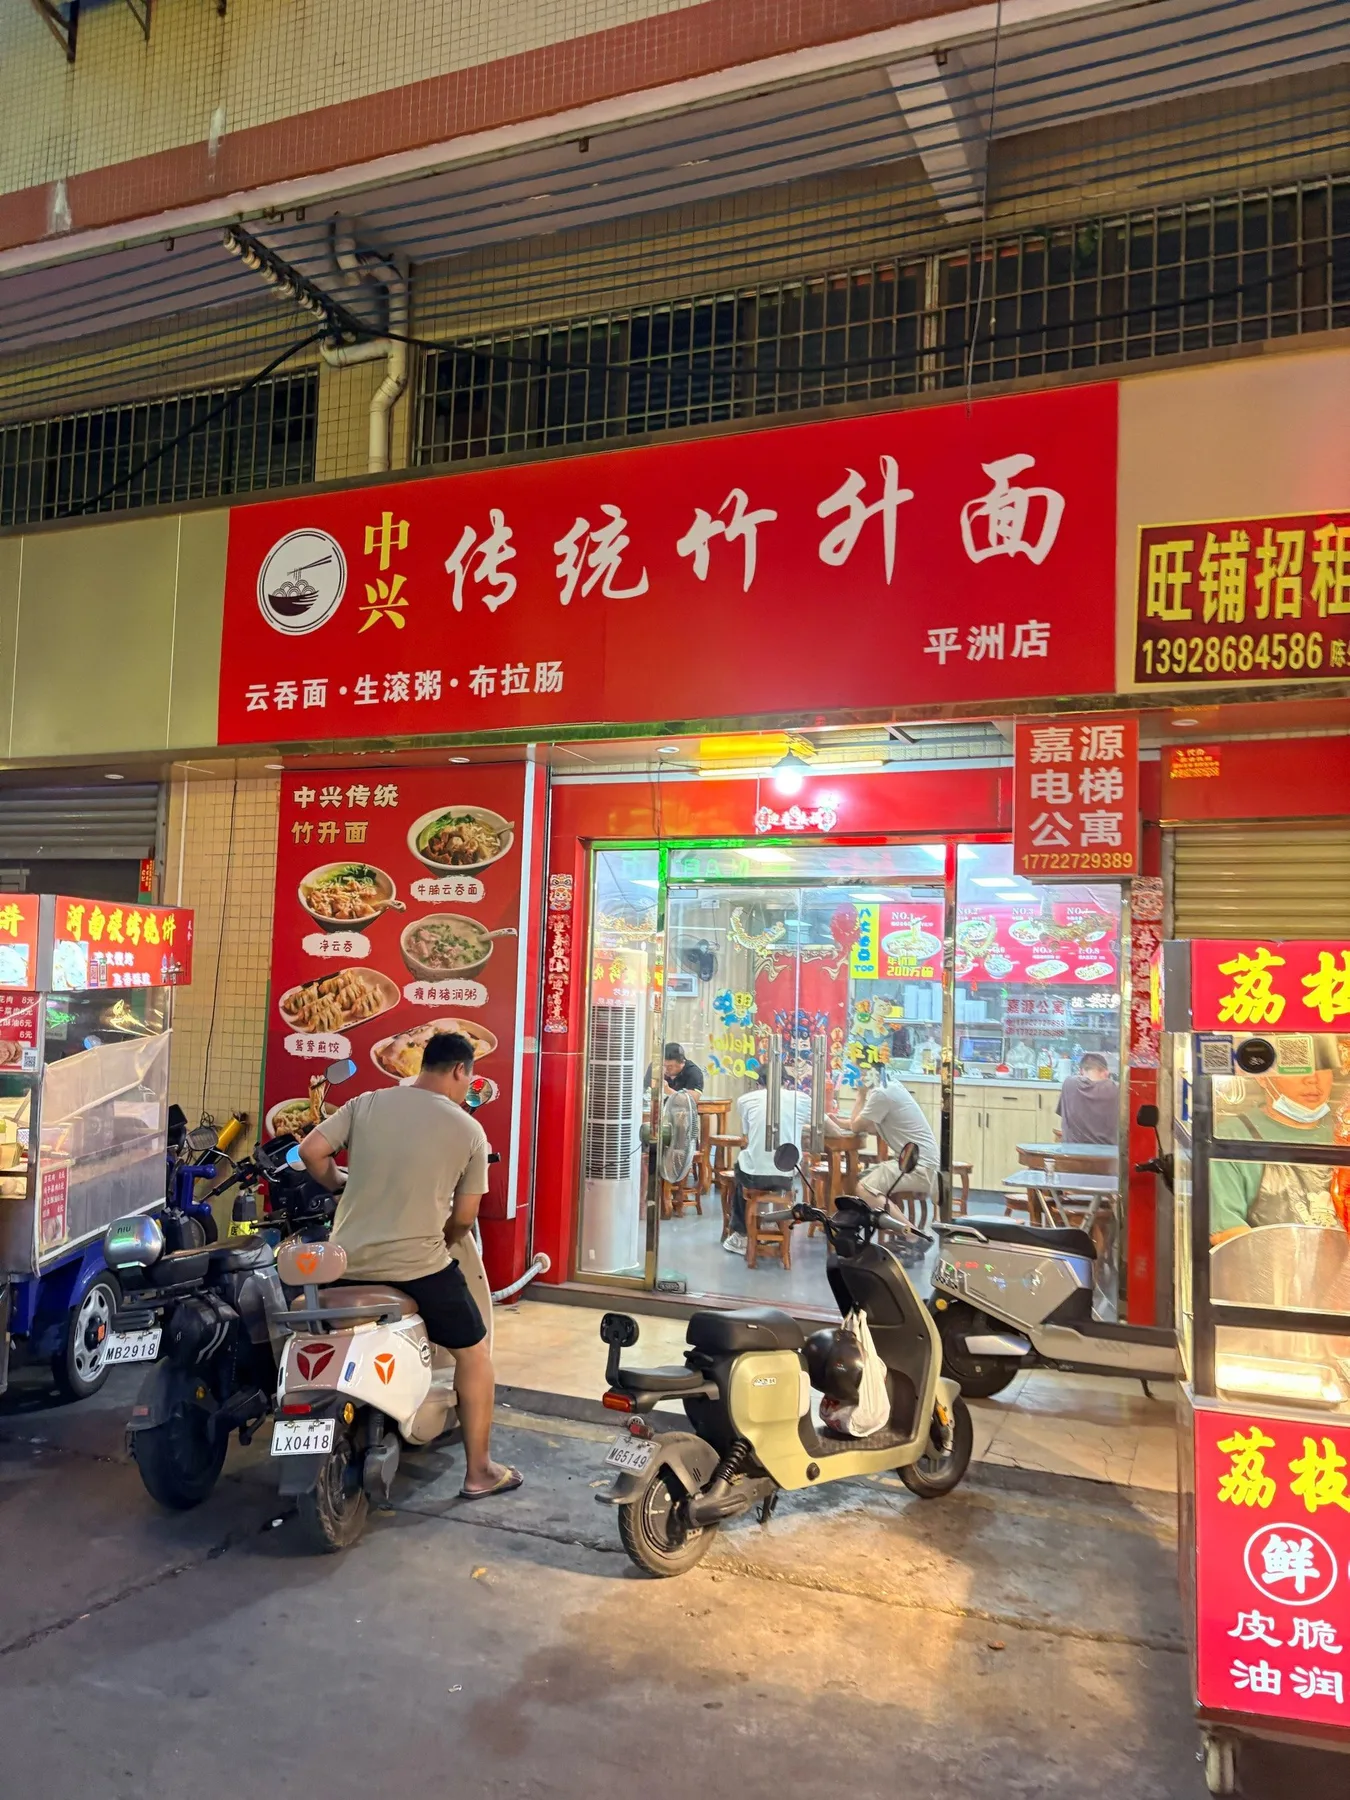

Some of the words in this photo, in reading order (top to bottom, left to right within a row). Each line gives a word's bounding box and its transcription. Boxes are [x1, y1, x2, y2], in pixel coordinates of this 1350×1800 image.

[444, 453, 1065, 612] 传统竹升面
[358, 512, 410, 634] 中兴
[1147, 522, 1350, 624] 旺铺招租
[923, 619, 1051, 664] 平洲店
[1142, 632, 1322, 674] 13928684586
[1329, 637, 1350, 669] 陈
[1029, 725, 1126, 764] 嘉源
[293, 784, 399, 809] 中兴传统
[1030, 767, 1124, 804] 电梯
[291, 821, 368, 844] 竹升面
[1028, 810, 1123, 847] 公寓
[1021, 852, 1133, 870] 17722729389
[319, 940, 353, 952] 净云吞
[413, 986, 478, 1001] 瘦肉猪润粥
[295, 1038, 340, 1054] 鸳鸯煎饺
[106, 1343, 156, 1360] MB2918
[275, 1434, 330, 1452] LX0418
[608, 1448, 647, 1468] MG5149
[1217, 1425, 1350, 1513] 荔枝
[1261, 1534, 1320, 1595] 鲜
[1227, 1609, 1343, 1654] 皮脆
[1228, 1659, 1344, 1704] 油润
